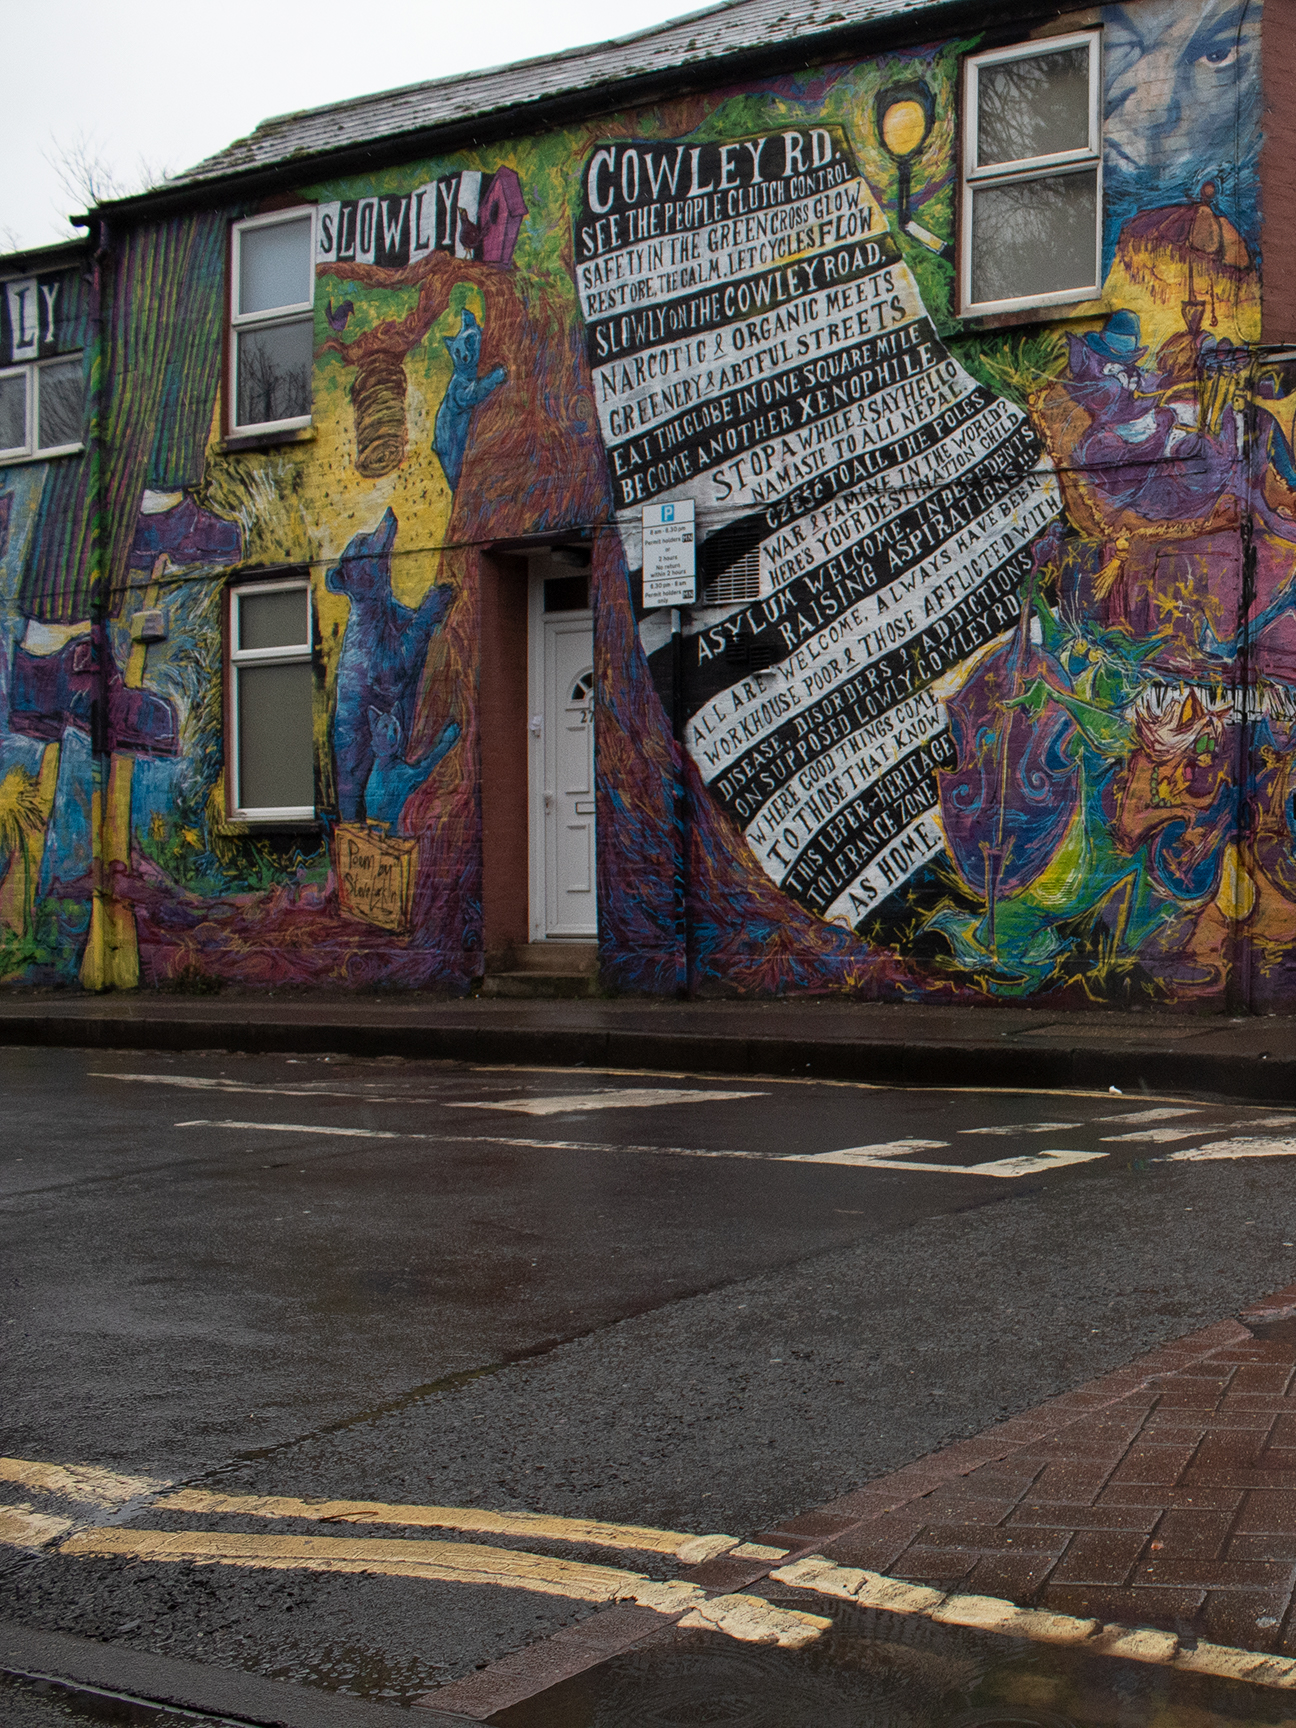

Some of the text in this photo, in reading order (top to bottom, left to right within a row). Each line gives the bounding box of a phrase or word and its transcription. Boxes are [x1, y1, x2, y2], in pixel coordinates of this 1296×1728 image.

[320, 178, 459, 257] SLOWLY
[582, 162, 851, 257] SEE THE PEOPLE CLUTCH CONTROL
[582, 248, 644, 290] SAFETY
[647, 240, 664, 272] IN
[667, 232, 701, 265] THE
[813, 181, 861, 220] GLOW
[588, 129, 841, 214] COWLEY RD.
[818, 206, 873, 248] FLOW
[596, 306, 668, 357] SLOWLY
[724, 257, 821, 317] COWLEY
[823, 242, 887, 282] ROAD,
[600, 339, 707, 403] NARCOTIC
[732, 298, 819, 351] ORGANIC
[825, 270, 896, 317] MEETS
[609, 374, 703, 437] GREENERY
[718, 339, 795, 392] ARTFUL
[797, 295, 907, 356] STREETS
[612, 324, 922, 476] EAT THE GLOBE IN ONE SQUARE MILE
[620, 342, 937, 503] BECOME ANOTHER XENOPHILE
[712, 443, 776, 502] STOP
[781, 438, 798, 462] A
[795, 409, 855, 451] WHILE
[867, 388, 901, 423] SAY
[899, 361, 958, 409] HELLO
[750, 446, 828, 502] NAMASTE
[831, 434, 857, 460] TO
[862, 417, 900, 449] ALL
[763, 524, 807, 565] WAR
[821, 473, 892, 526] FAMINE
[897, 460, 923, 483] IN
[922, 442, 952, 472] THE
[951, 400, 1008, 450] WORLD?
[816, 510, 866, 556] YOUR
[863, 445, 977, 527] DESTINATION
[979, 412, 1020, 450] CHILD
[824, 464, 850, 493] TO
[853, 449, 889, 483] ALL
[890, 430, 931, 462] THE
[932, 391, 985, 439] POLES
[692, 703, 727, 747] ALL
[730, 675, 767, 713] ARE
[876, 549, 953, 615] ALWAYS
[955, 511, 999, 554] HAVE
[1000, 474, 1042, 518] BEEN
[697, 587, 798, 667] ASYLUM
[703, 685, 802, 767] WORKHOUSE
[802, 658, 843, 698] POOR
[857, 609, 918, 658] THOSE
[923, 533, 1016, 618] AFFLICTED
[1011, 495, 1060, 541] WITH
[778, 563, 878, 650] RAISING
[792, 660, 892, 738] DISORDERS
[921, 552, 1032, 653] ADDICTIONS
[734, 784, 763, 818] ON
[760, 713, 851, 791] SUPPOSED
[854, 669, 913, 724] LOWLY
[917, 610, 992, 680] COWLEY
[748, 685, 941, 846] WHERE GOOD THINGS COME
[766, 706, 940, 869] TO THOSE THAT KNOW
[806, 778, 937, 906] TOLERANCE ZONE
[786, 849, 824, 893] THIS
[848, 821, 943, 917] AS HOME.
